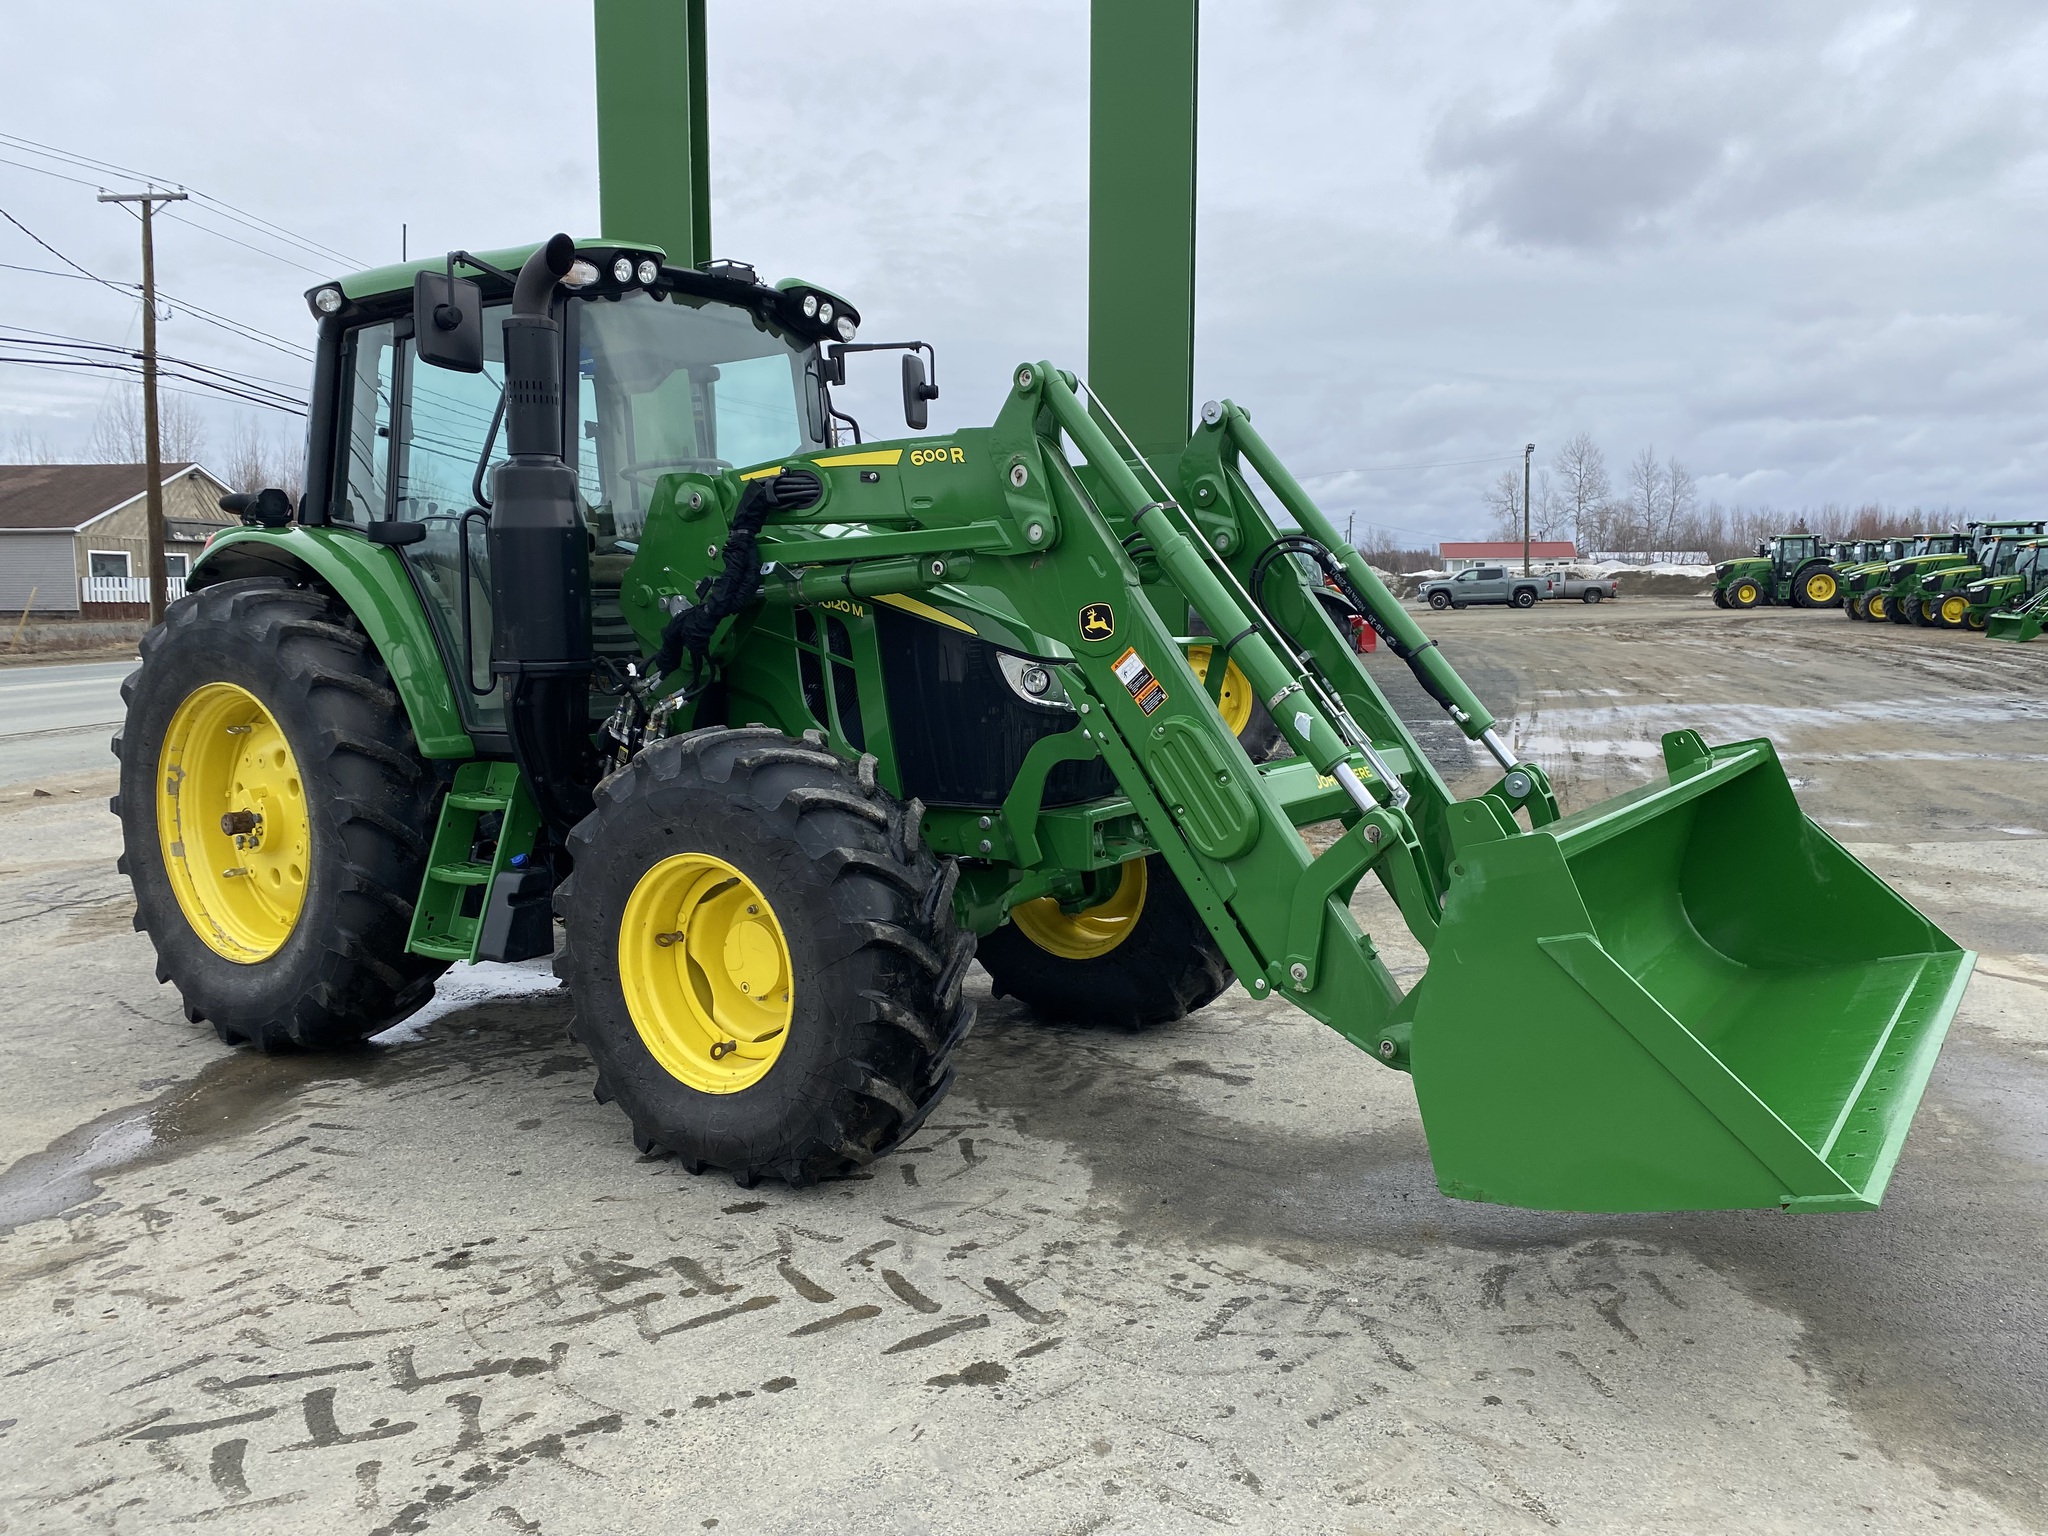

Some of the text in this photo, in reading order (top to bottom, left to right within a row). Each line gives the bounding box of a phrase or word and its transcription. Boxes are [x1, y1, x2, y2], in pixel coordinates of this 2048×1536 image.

[910, 447, 966, 466] 600 R
[851, 603, 864, 618] M
[1315, 774, 1340, 790] JOH
